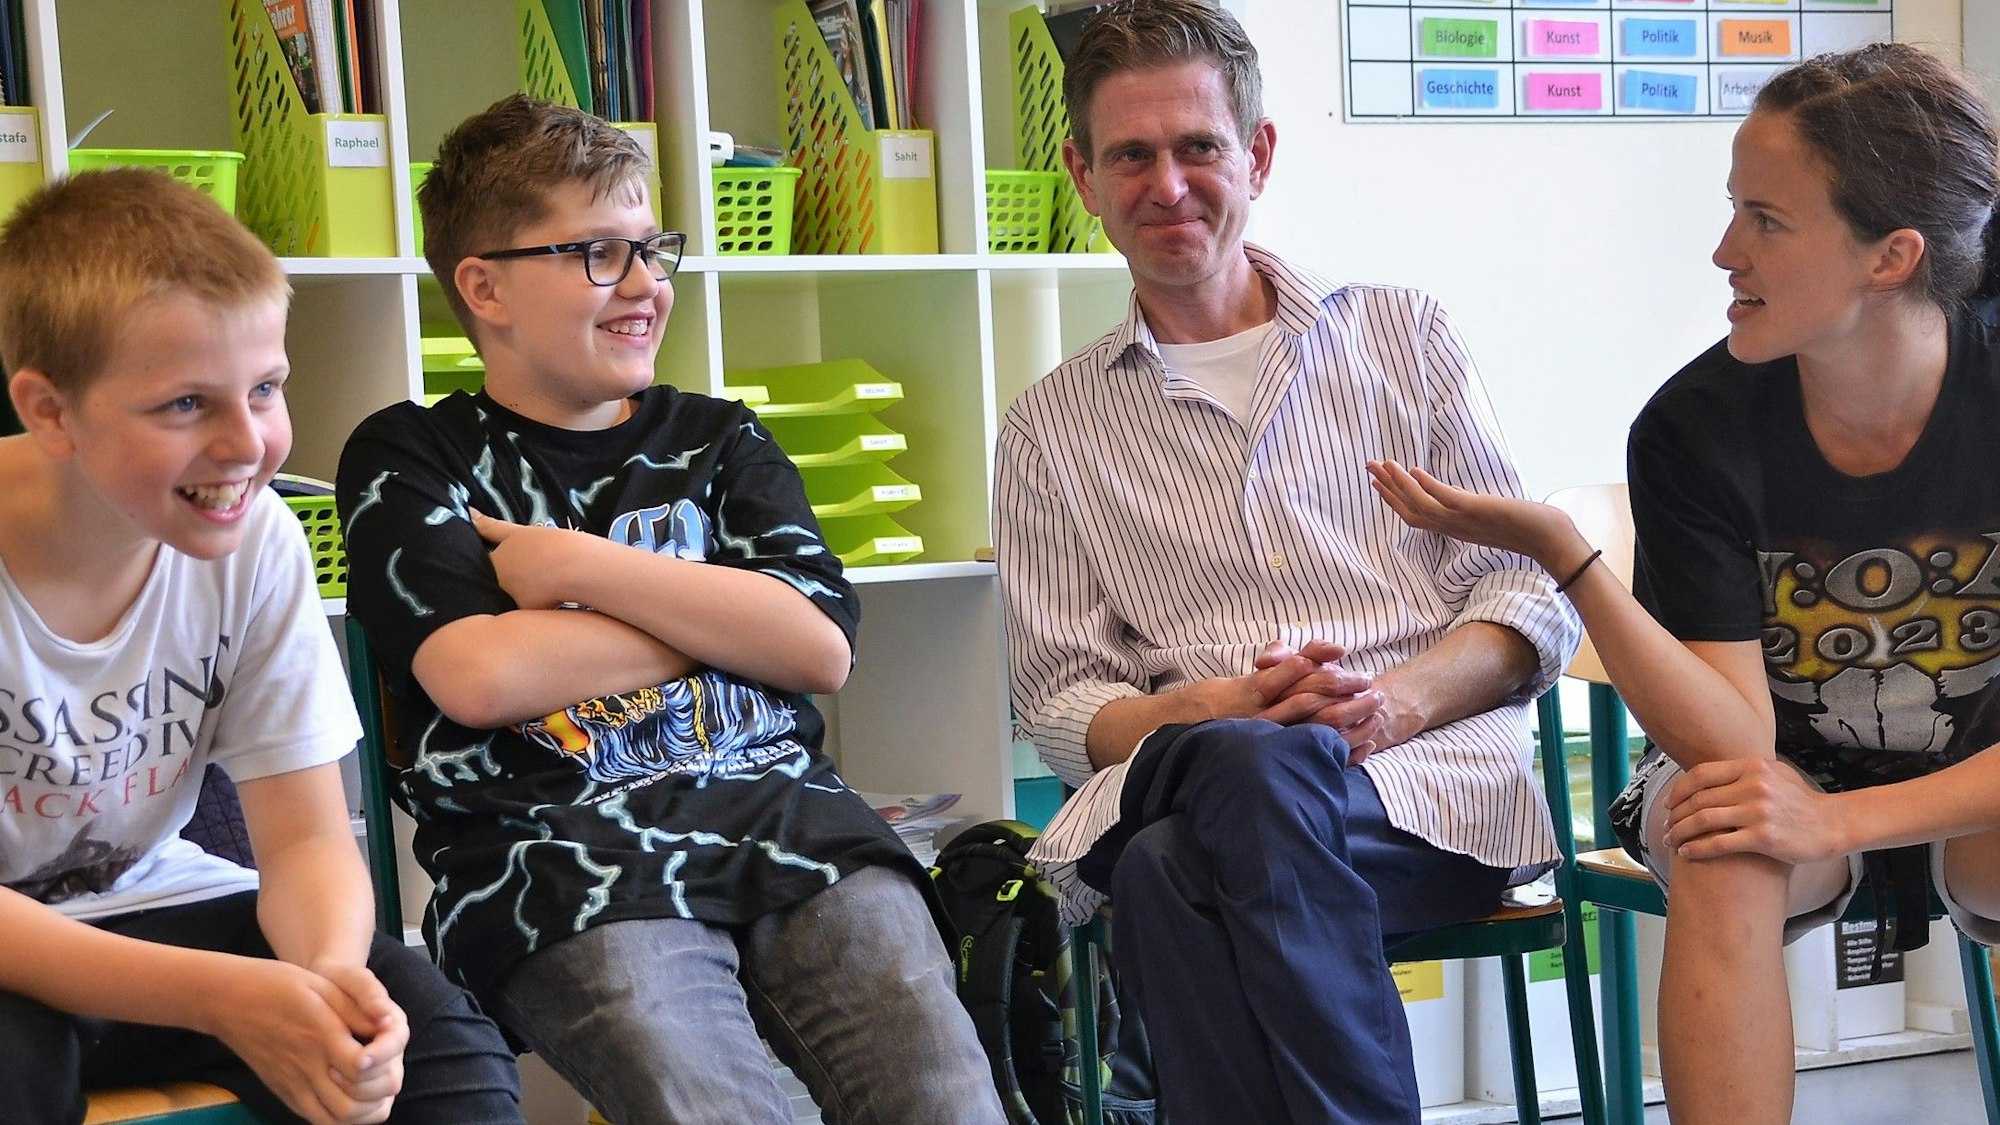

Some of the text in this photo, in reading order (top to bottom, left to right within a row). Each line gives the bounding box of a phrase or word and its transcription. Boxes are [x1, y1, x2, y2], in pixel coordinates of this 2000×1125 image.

[1435, 30, 1485, 47] Biologie
[1547, 31, 1581, 44] Kunst
[1642, 30, 1679, 43] Politik
[1738, 31, 1773, 43] Musik
[1427, 81, 1494, 95] Geschichte
[1547, 85, 1582, 97] Kunst
[1641, 83, 1679, 98] Politik
[335, 137, 379, 149] Raphael
[895, 152, 918, 162] Sahit
[1762, 609, 2000, 664] 2023
